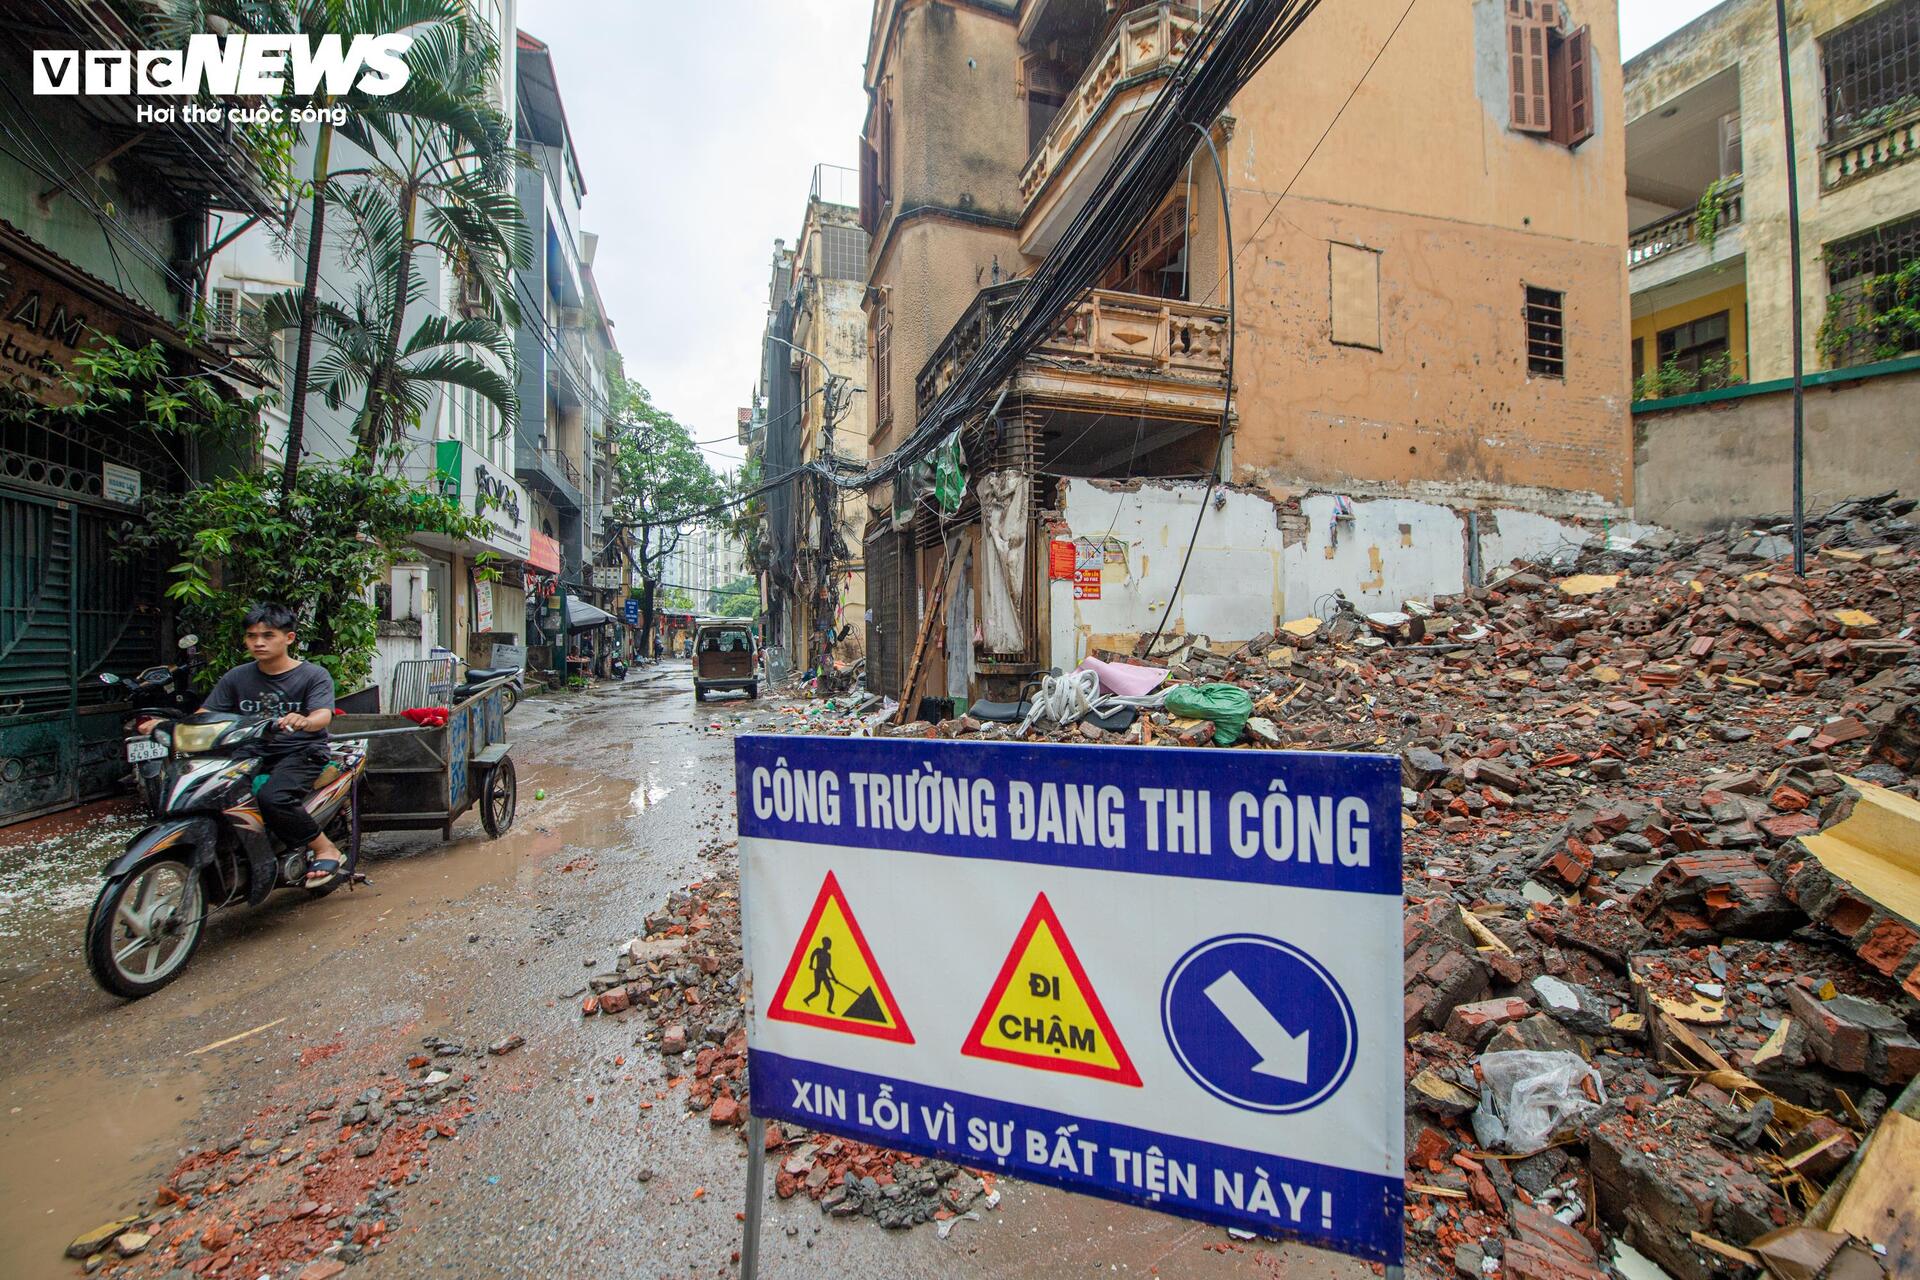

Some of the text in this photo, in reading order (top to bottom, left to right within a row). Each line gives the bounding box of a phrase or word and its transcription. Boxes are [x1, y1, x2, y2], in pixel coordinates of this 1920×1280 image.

[752, 757, 1371, 868] CÔNG TRƯỜNG ĐANG THI CÔNG
[1028, 972, 1060, 1001] ĐI
[998, 1014, 1096, 1055] CHẬM
[791, 1079, 846, 1121] XIN
[857, 1082, 910, 1134] LỖI
[920, 1098, 957, 1145] VÌ
[966, 1116, 1014, 1157] SỰ
[1026, 1124, 1098, 1176] BẤT
[1109, 1144, 1197, 1202] TIỆN
